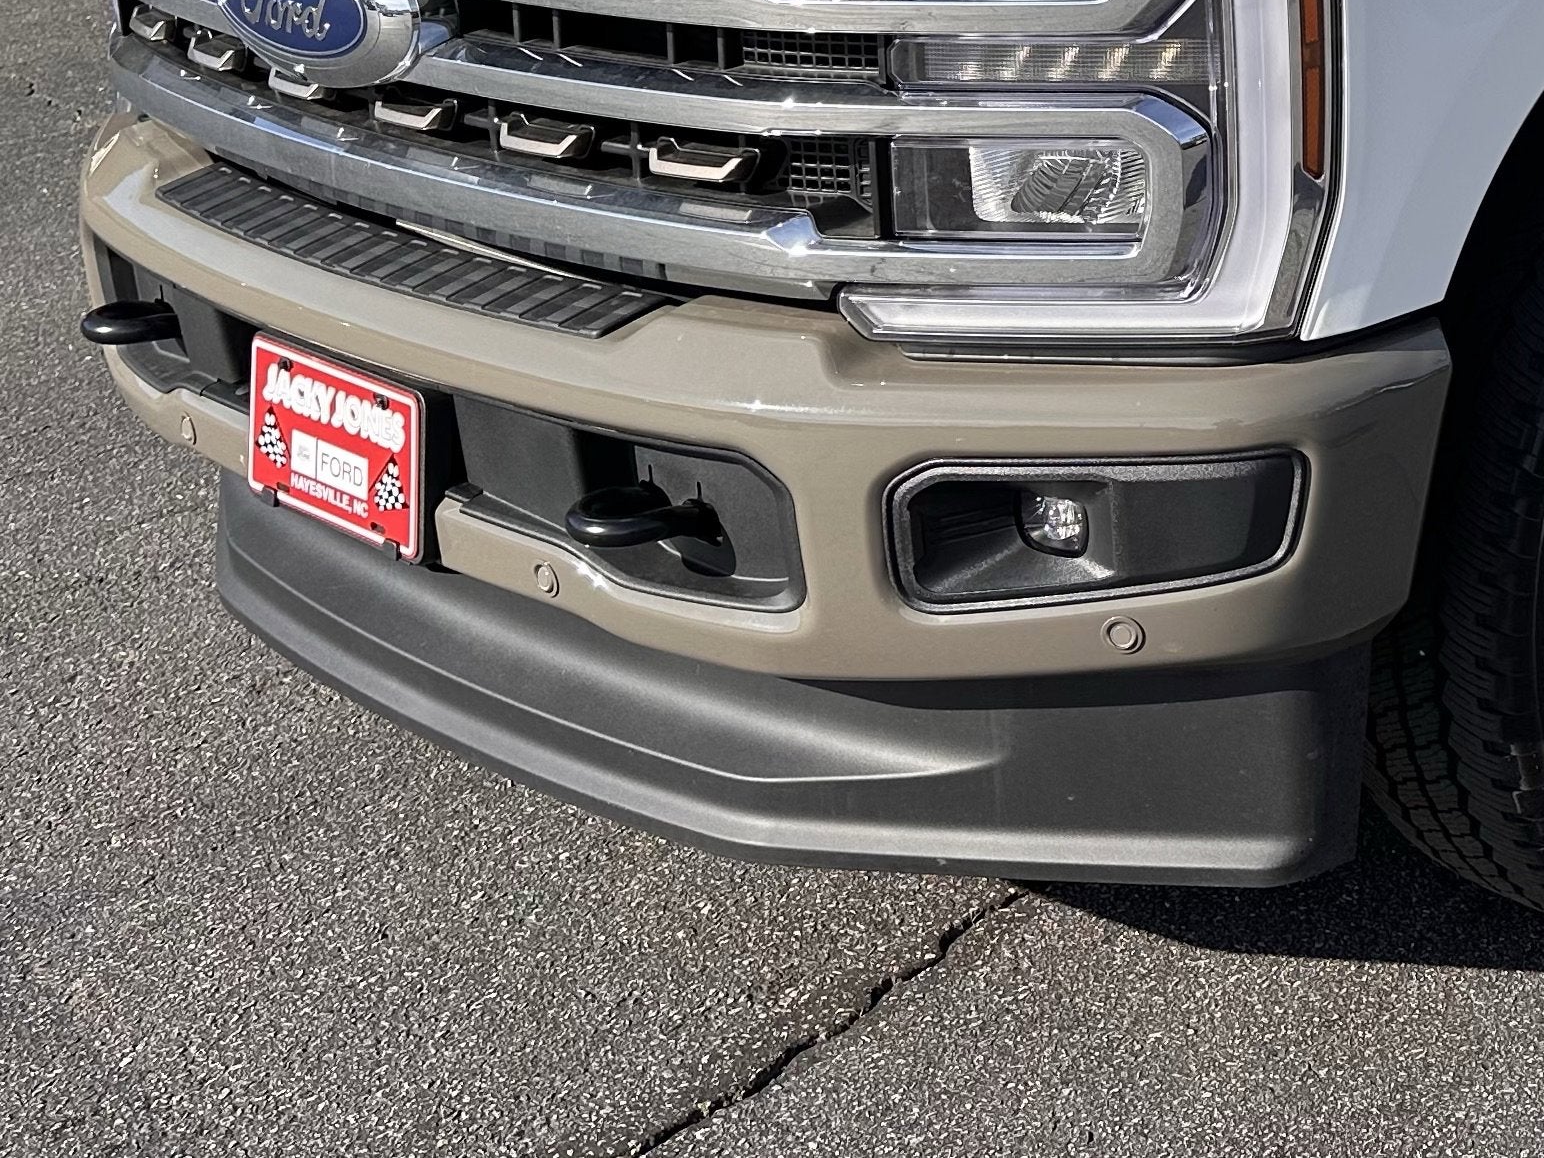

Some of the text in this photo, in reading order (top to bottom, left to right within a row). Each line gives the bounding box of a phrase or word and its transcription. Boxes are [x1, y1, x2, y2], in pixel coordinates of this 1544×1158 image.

[262, 363, 406, 453] JACKY JONES
[321, 452, 364, 487] FORD
[291, 472, 369, 519] HAYESVILLE, NC
